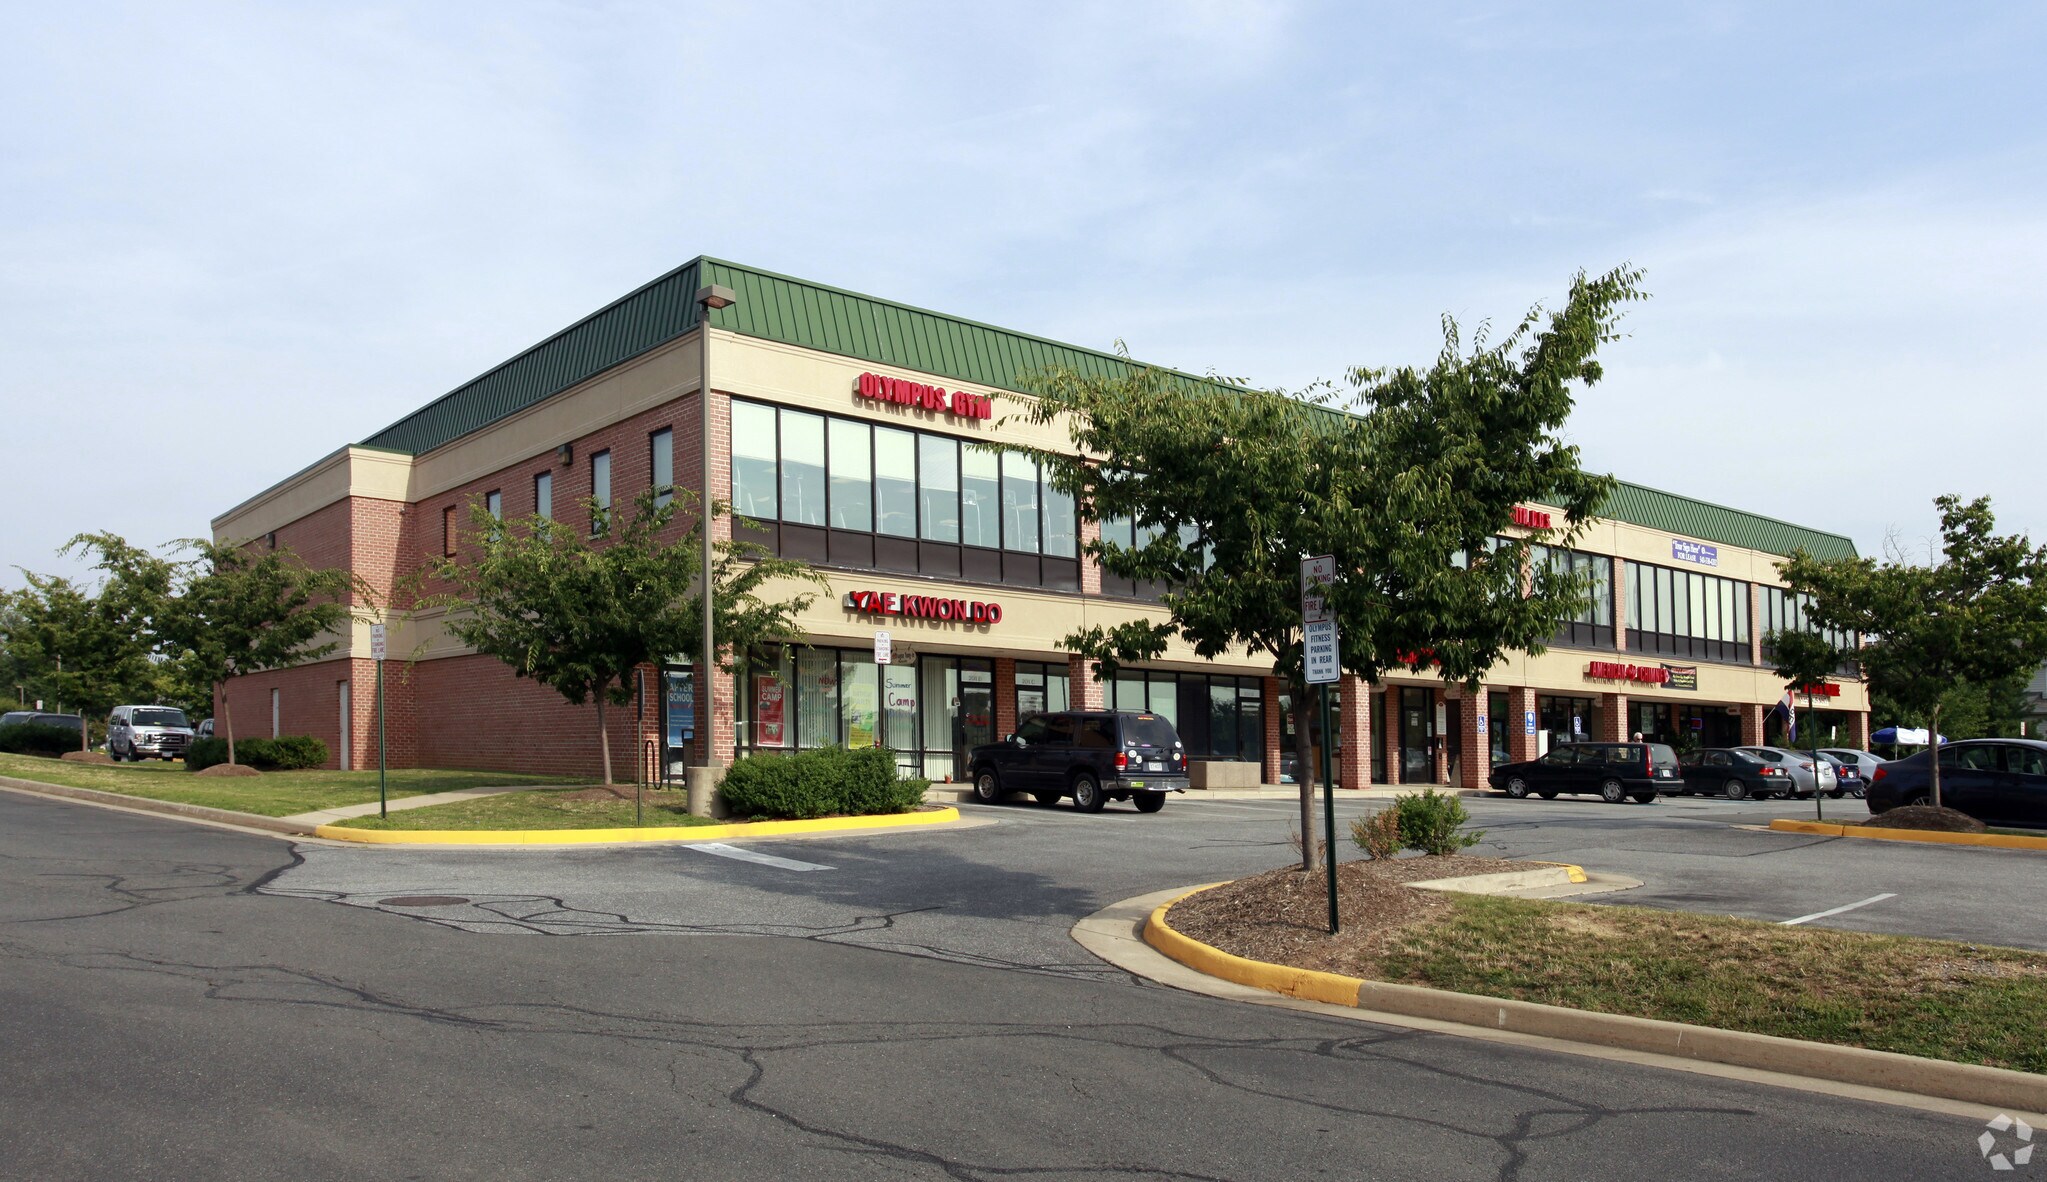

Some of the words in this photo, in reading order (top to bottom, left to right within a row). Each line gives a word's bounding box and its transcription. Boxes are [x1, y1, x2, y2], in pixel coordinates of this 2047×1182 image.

[859, 372, 947, 412] OLYMPUS
[951, 391, 992, 420] GYM
[1313, 565, 1323, 574] NO
[849, 590, 897, 615] TAE
[900, 594, 967, 621] KWON
[971, 601, 1002, 624] DO
[1305, 601, 1317, 612] FIRE
[1309, 623, 1332, 633] OLYMPUS
[1310, 634, 1331, 643] FITNESS
[1310, 644, 1332, 654] PARKING
[1311, 656, 1317, 665] IN
[1319, 655, 1332, 664] REAR
[1590, 661, 1626, 680] AMERICAN
[669, 693, 694, 702] SCHOOL
[761, 693, 782, 701] CAMP
[888, 692, 915, 709] Camp
